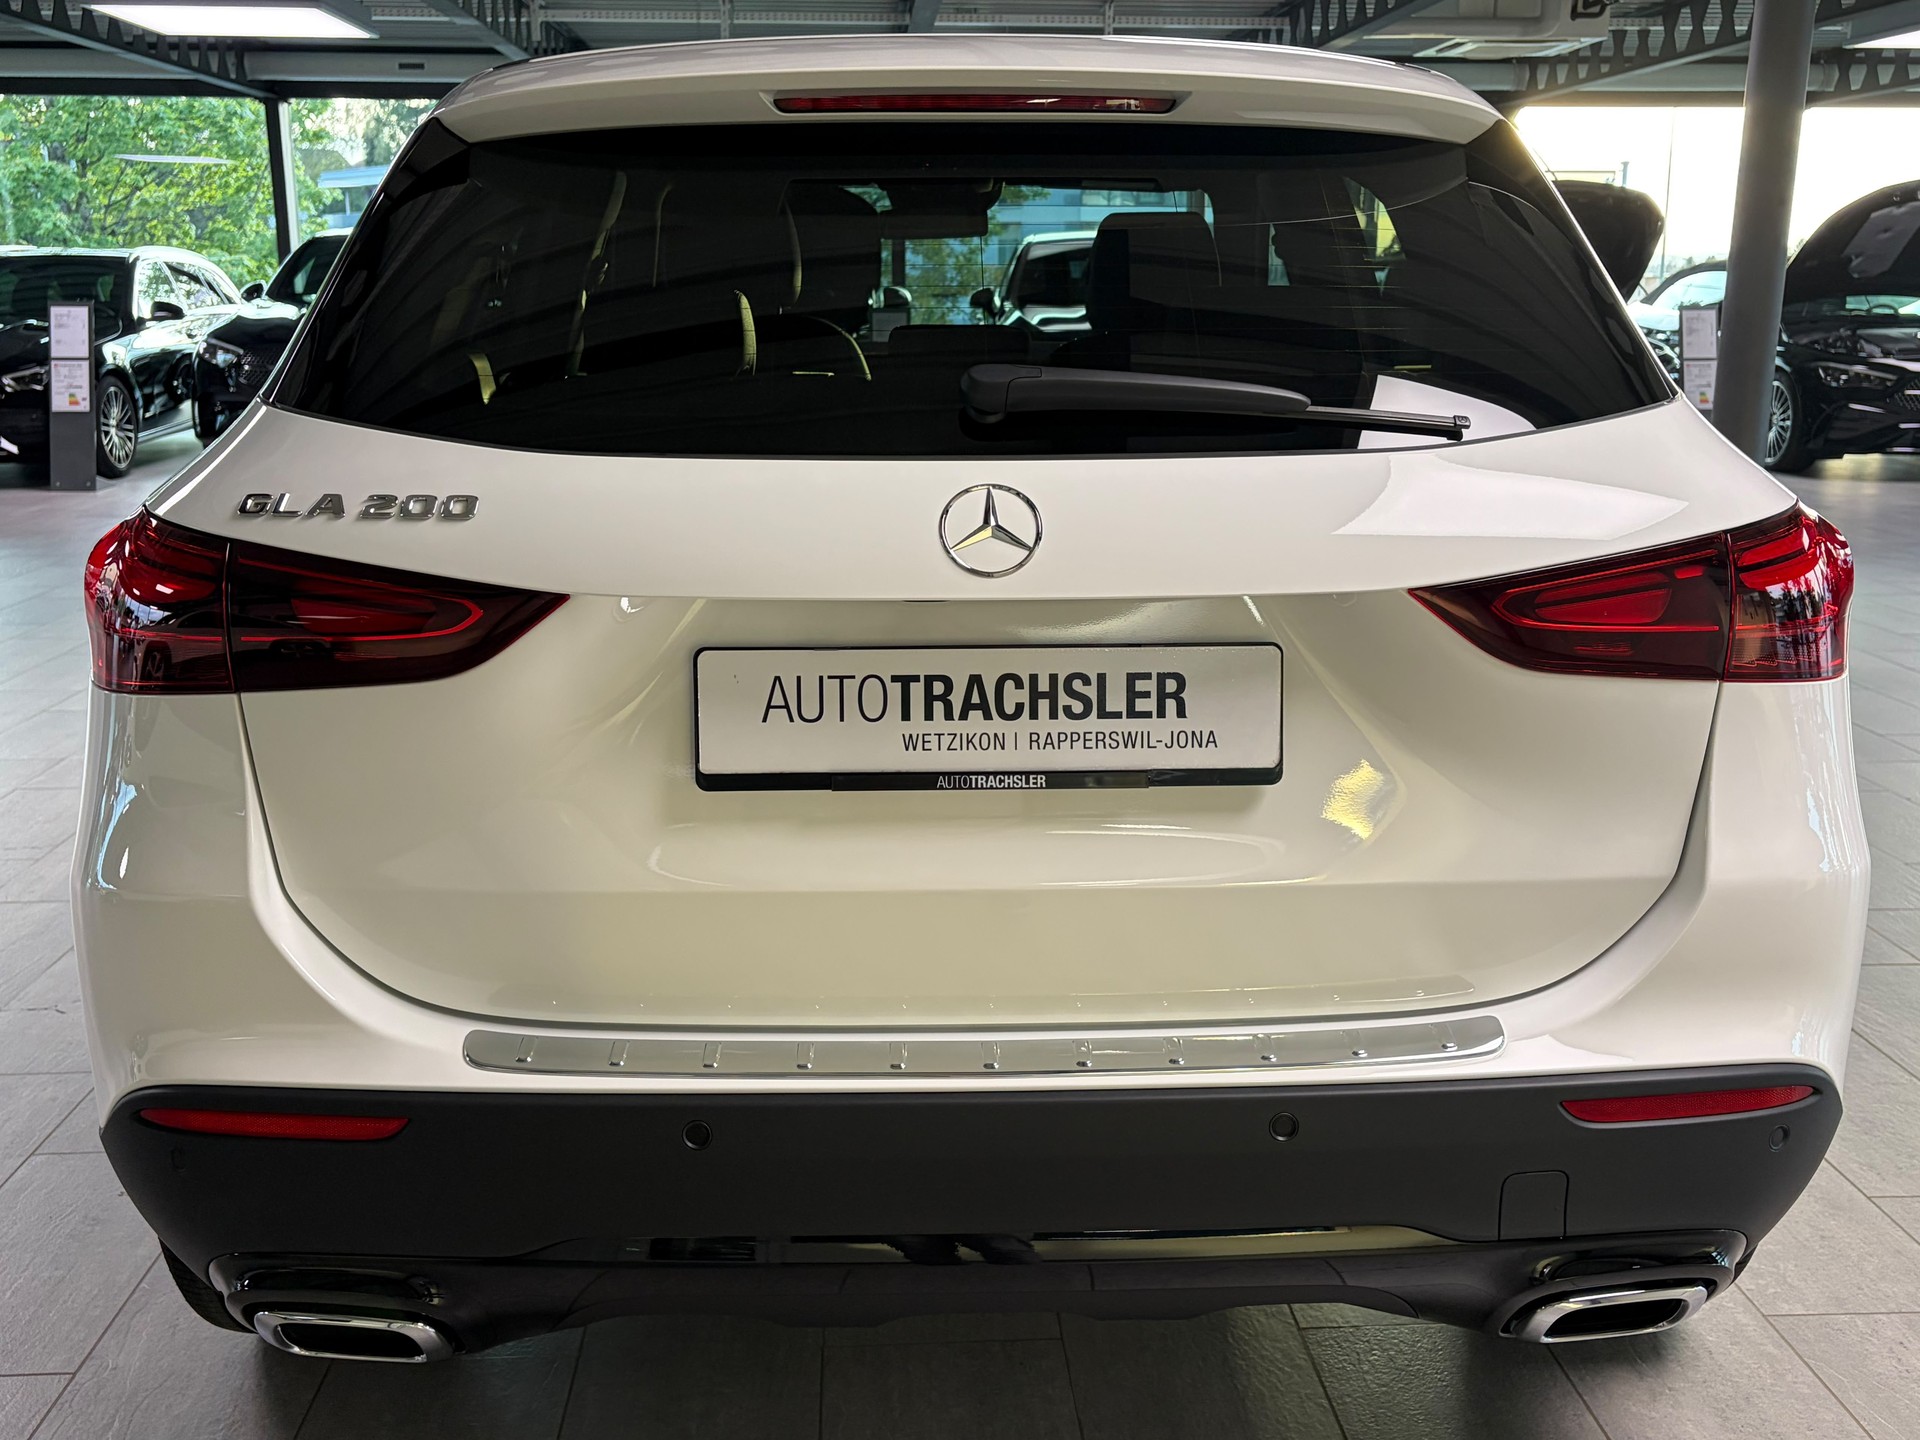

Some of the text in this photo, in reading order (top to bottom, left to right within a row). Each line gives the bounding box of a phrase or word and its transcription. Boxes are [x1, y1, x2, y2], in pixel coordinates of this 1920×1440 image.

[237, 492, 481, 520] GLA 200
[761, 672, 1188, 723] AUTOTRACHSLER
[902, 732, 1006, 751] WETZIKON
[1029, 730, 1218, 750] RAPPERSWIL-JONA
[936, 774, 1047, 789] AUTOTRACHSLER
